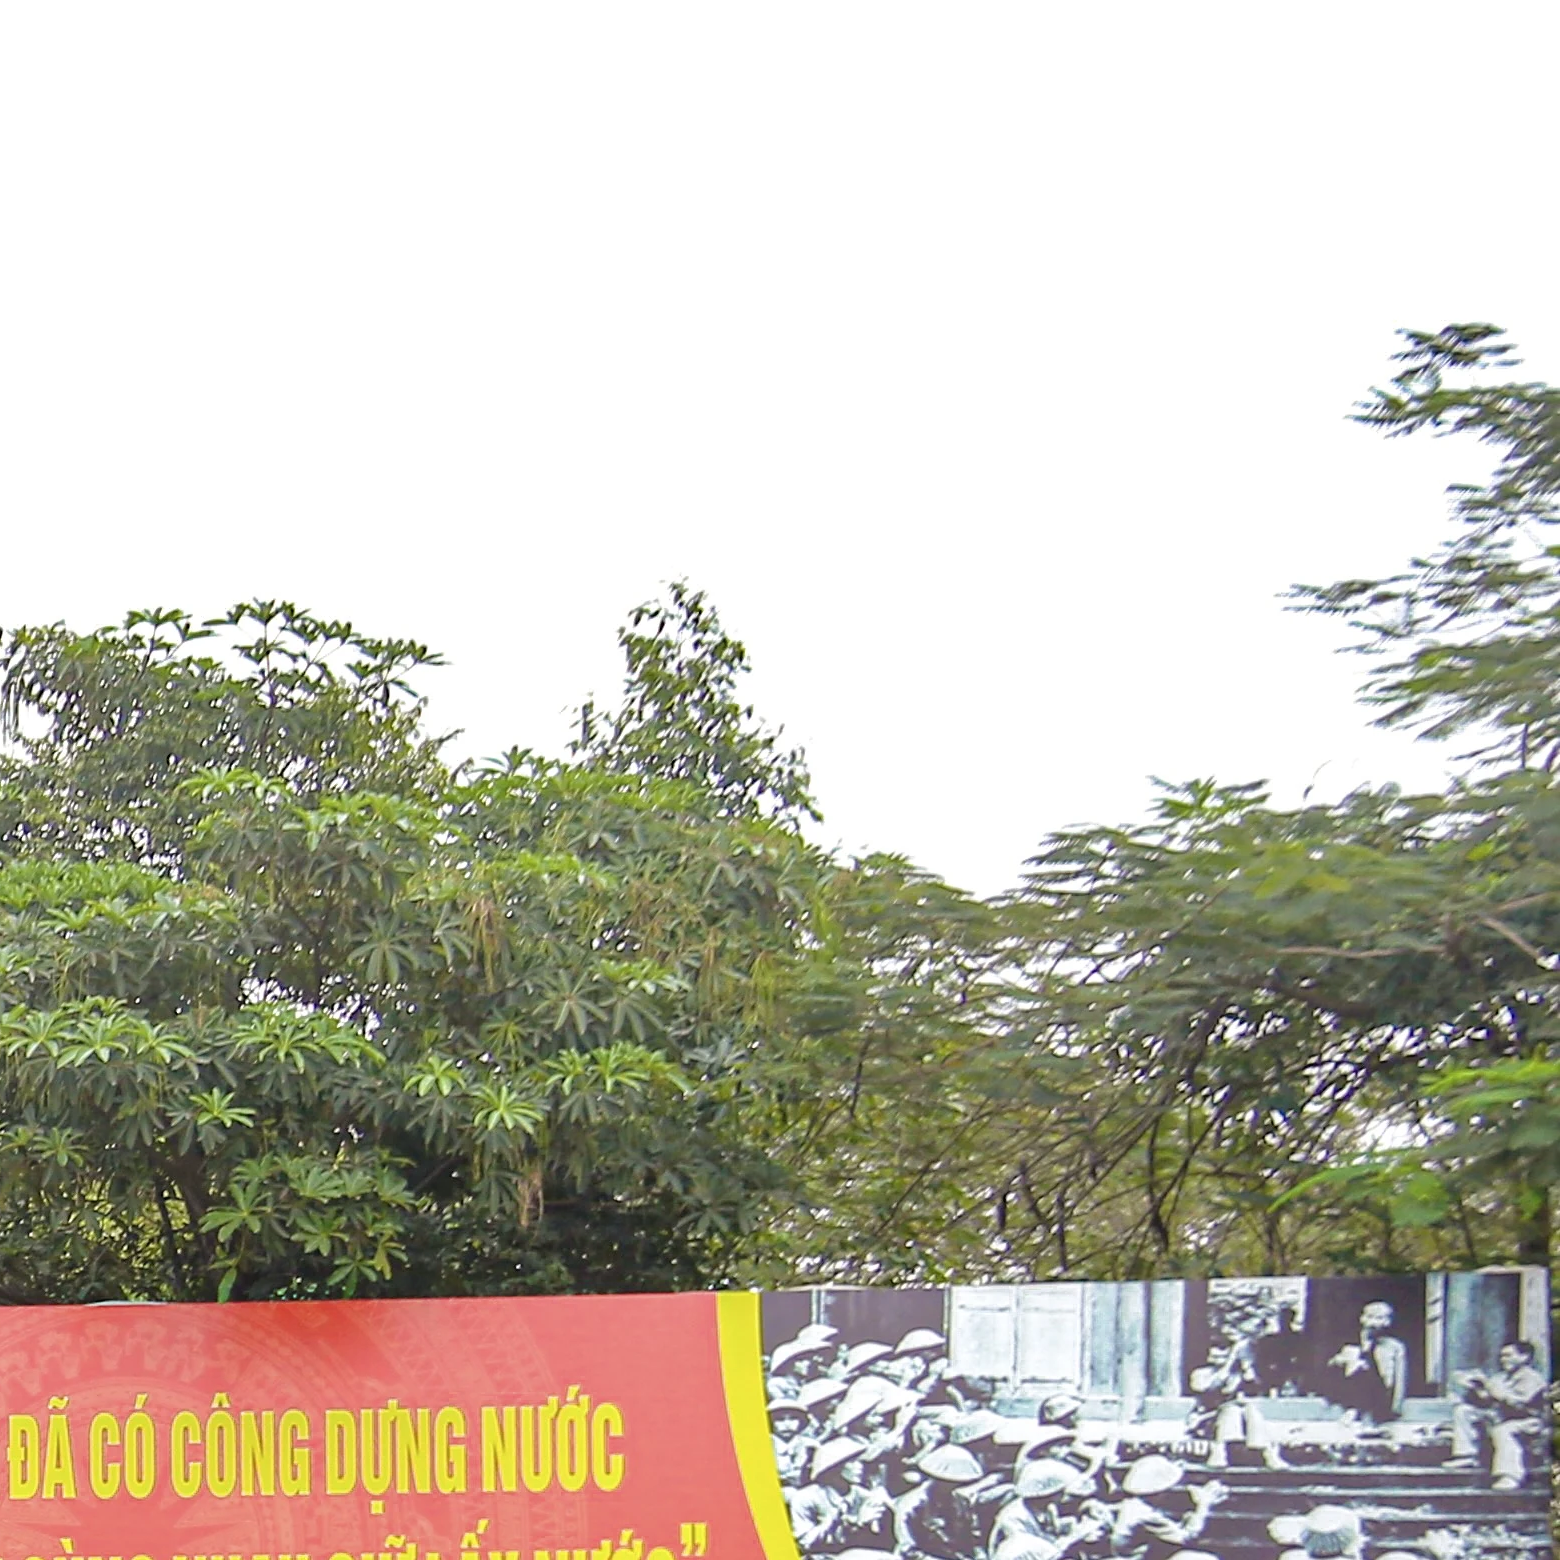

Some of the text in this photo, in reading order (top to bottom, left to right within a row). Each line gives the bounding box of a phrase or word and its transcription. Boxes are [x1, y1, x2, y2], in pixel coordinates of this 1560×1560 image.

[6, 1396, 79, 1501] ĐÃ
[88, 1393, 157, 1500] CÓ
[170, 1391, 311, 1499] CÔNG
[324, 1399, 468, 1516] DỰNG
[480, 1384, 626, 1494] NƯỚC
